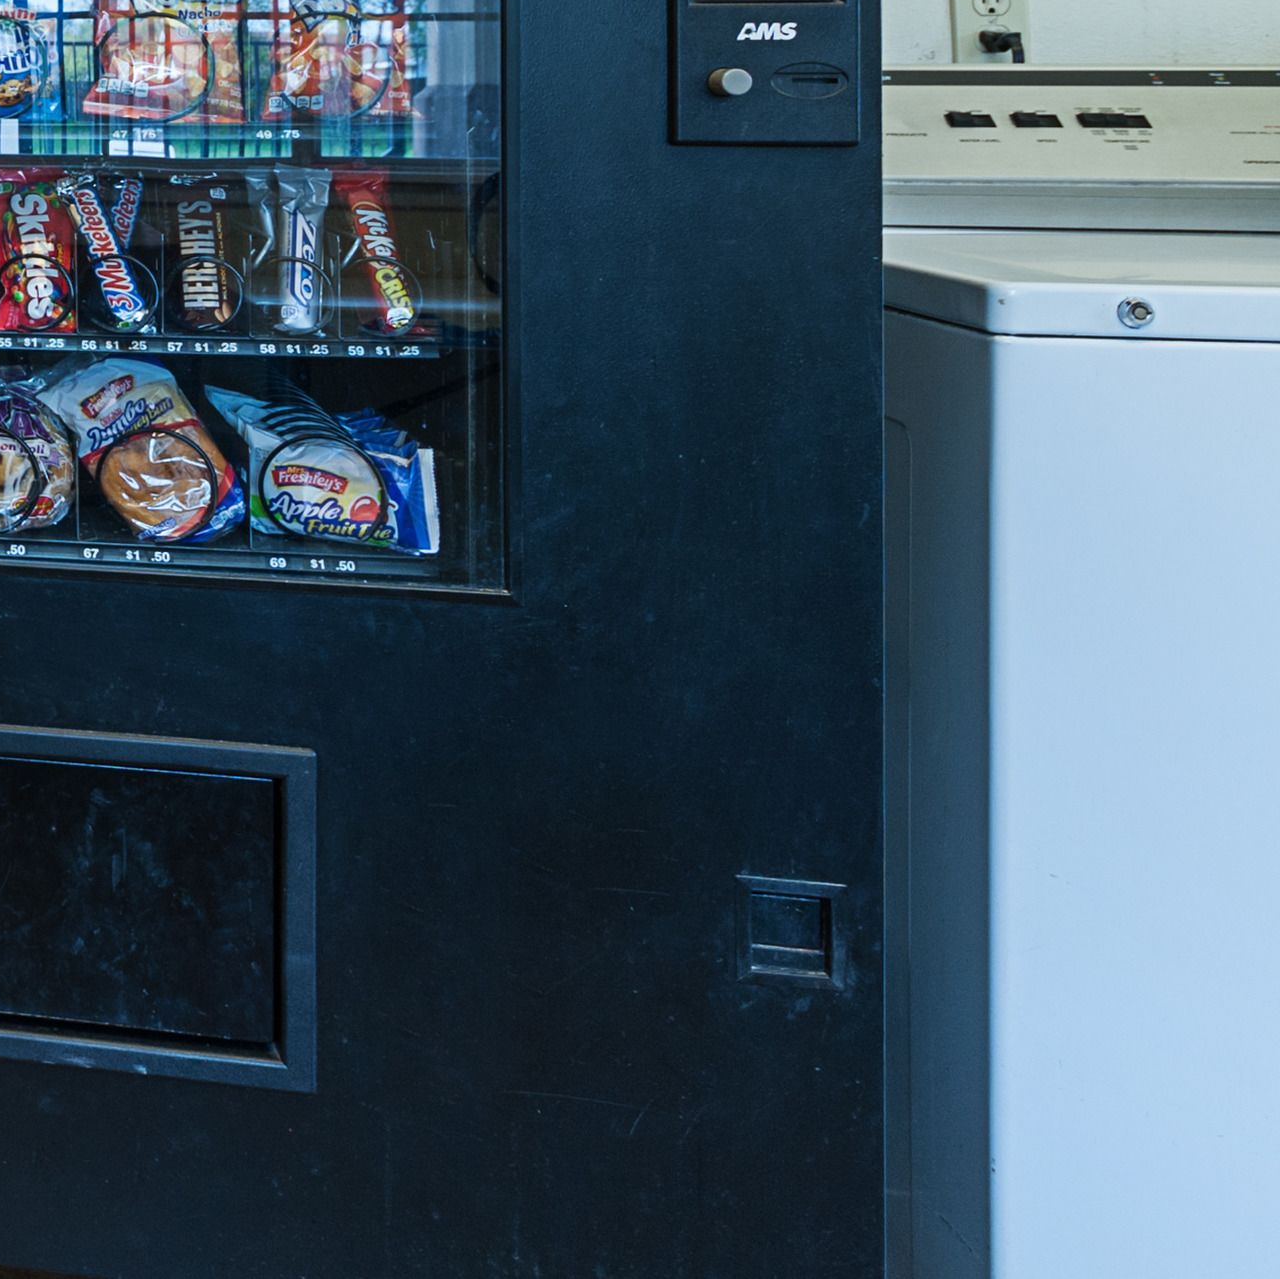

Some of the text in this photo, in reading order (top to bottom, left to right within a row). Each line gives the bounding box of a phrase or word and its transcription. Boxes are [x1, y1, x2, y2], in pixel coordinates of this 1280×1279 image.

[178, 6, 222, 21] Nacho
[737, 22, 797, 41] AMS
[256, 129, 301, 140] 49 .75
[45, 337, 65, 349] .25
[81, 340, 148, 352] 56 $1 .25
[167, 342, 238, 353] 57 $1 .25
[260, 344, 329, 356] 58 $1 .25
[348, 345, 420, 357] 59 $1 .25
[278, 470, 344, 492] Freshley's
[270, 493, 342, 521] Apple
[306, 519, 357, 537] Fruit
[6, 544, 26, 556] .50
[83, 548, 171, 563] 67 $1 .50
[269, 557, 356, 572] 69 $1 .50
